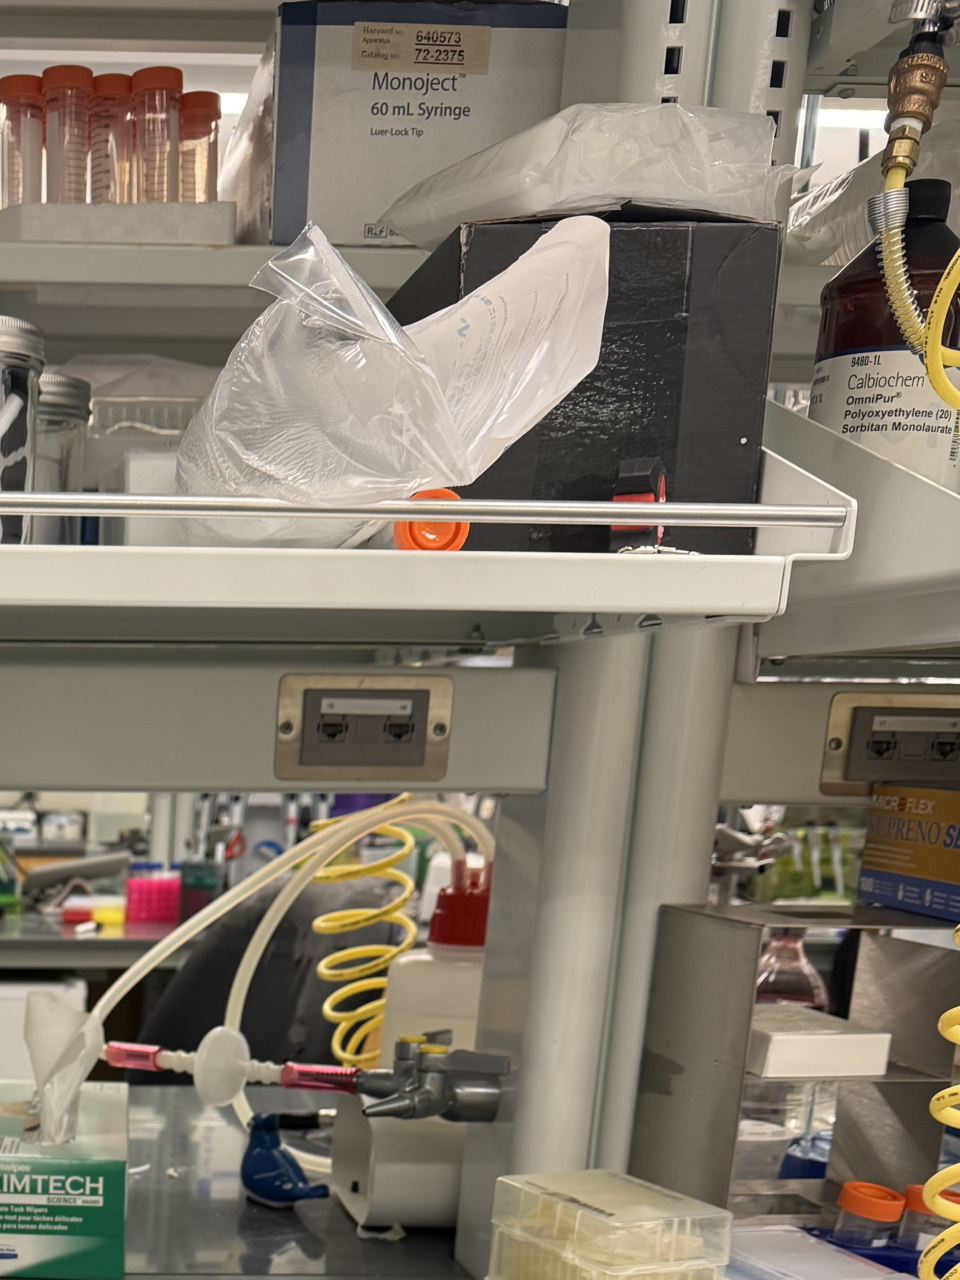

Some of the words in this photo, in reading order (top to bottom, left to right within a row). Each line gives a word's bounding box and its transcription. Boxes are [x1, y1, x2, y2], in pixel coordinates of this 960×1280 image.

[362, 36, 390, 44] Apparatus
[363, 26, 394, 35] Harvard
[416, 30, 461, 44] 640573
[361, 51, 388, 60] Catalog
[414, 48, 464, 62] 72-2375
[370, 102, 388, 116] 60
[392, 102, 414, 116] mL
[418, 102, 470, 120] Syringe
[370, 128, 409, 136] Luer-Lock
[411, 128, 424, 138] Tip
[851, 355, 882, 367] 9480-1L
[848, 372, 925, 390] Calbiochem
[844, 408, 933, 420] Polyoxyethylene
[935, 409, 952, 422] (20)
[842, 423, 888, 434] Sorbitan
[892, 422, 952, 434] Monolaurate
[26, 1206, 48, 1214] Wipers
